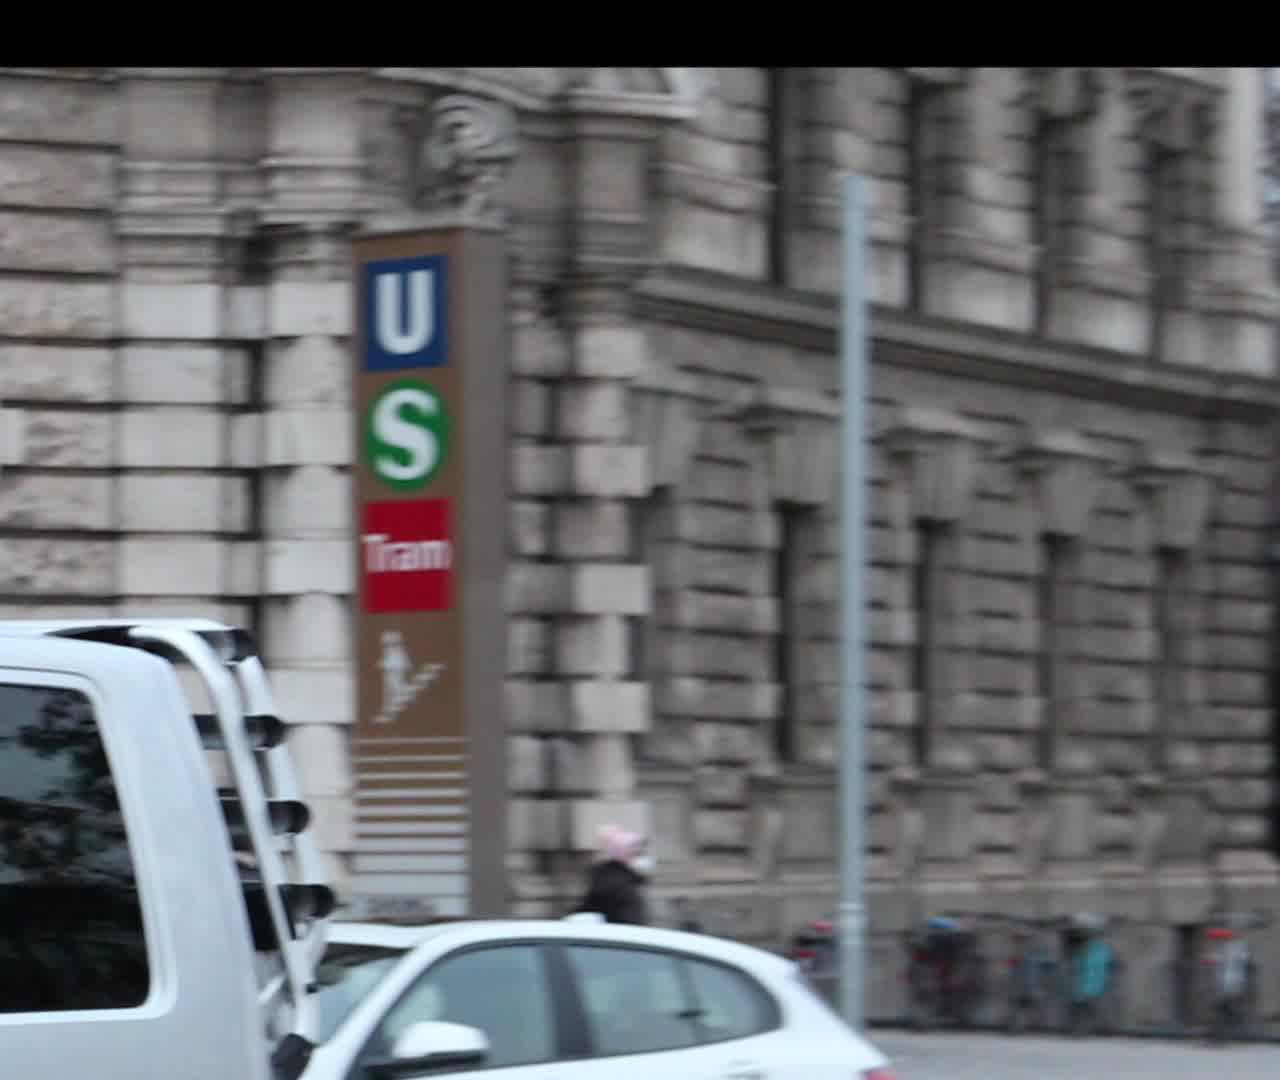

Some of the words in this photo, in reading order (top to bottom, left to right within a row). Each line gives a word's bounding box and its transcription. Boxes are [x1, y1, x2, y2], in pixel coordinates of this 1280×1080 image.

[374, 269, 435, 354] U
[372, 388, 439, 480] S
[361, 534, 451, 573] Tram
